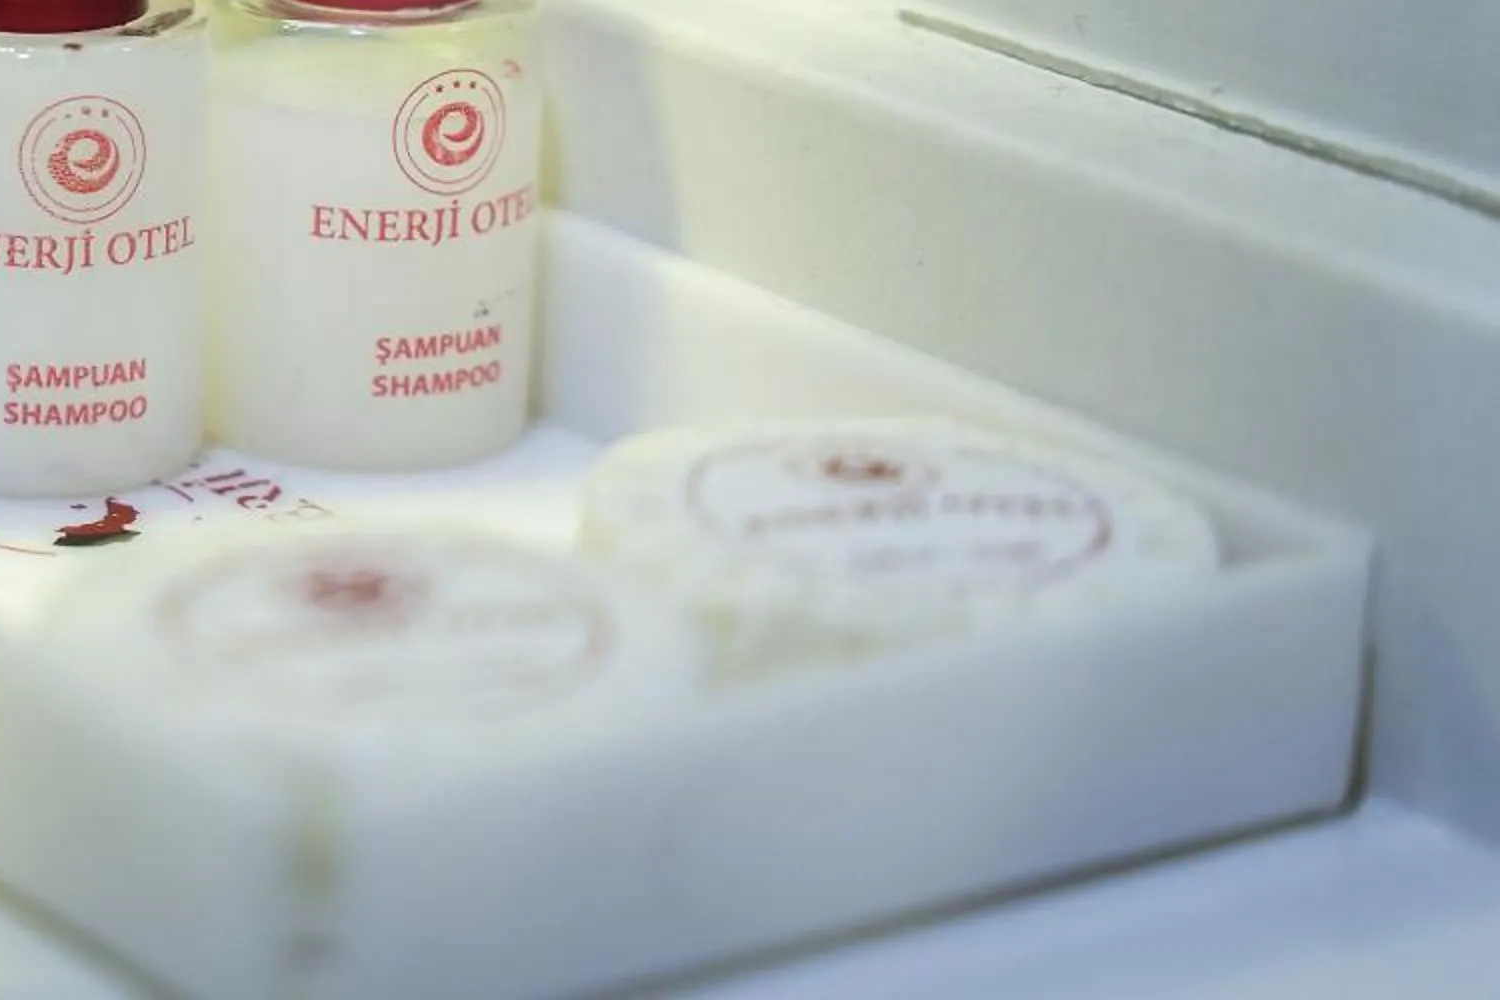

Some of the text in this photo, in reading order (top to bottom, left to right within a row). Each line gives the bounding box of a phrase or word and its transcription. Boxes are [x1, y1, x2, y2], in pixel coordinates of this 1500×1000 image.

[107, 215, 195, 266] OTEL
[310, 199, 461, 247] ENERJİ
[374, 323, 502, 365] ŞAMPUAN
[5, 357, 147, 393] ŞAMPUAN
[371, 360, 502, 399] SHAMPOO
[3, 395, 148, 427] SHAMPOO
